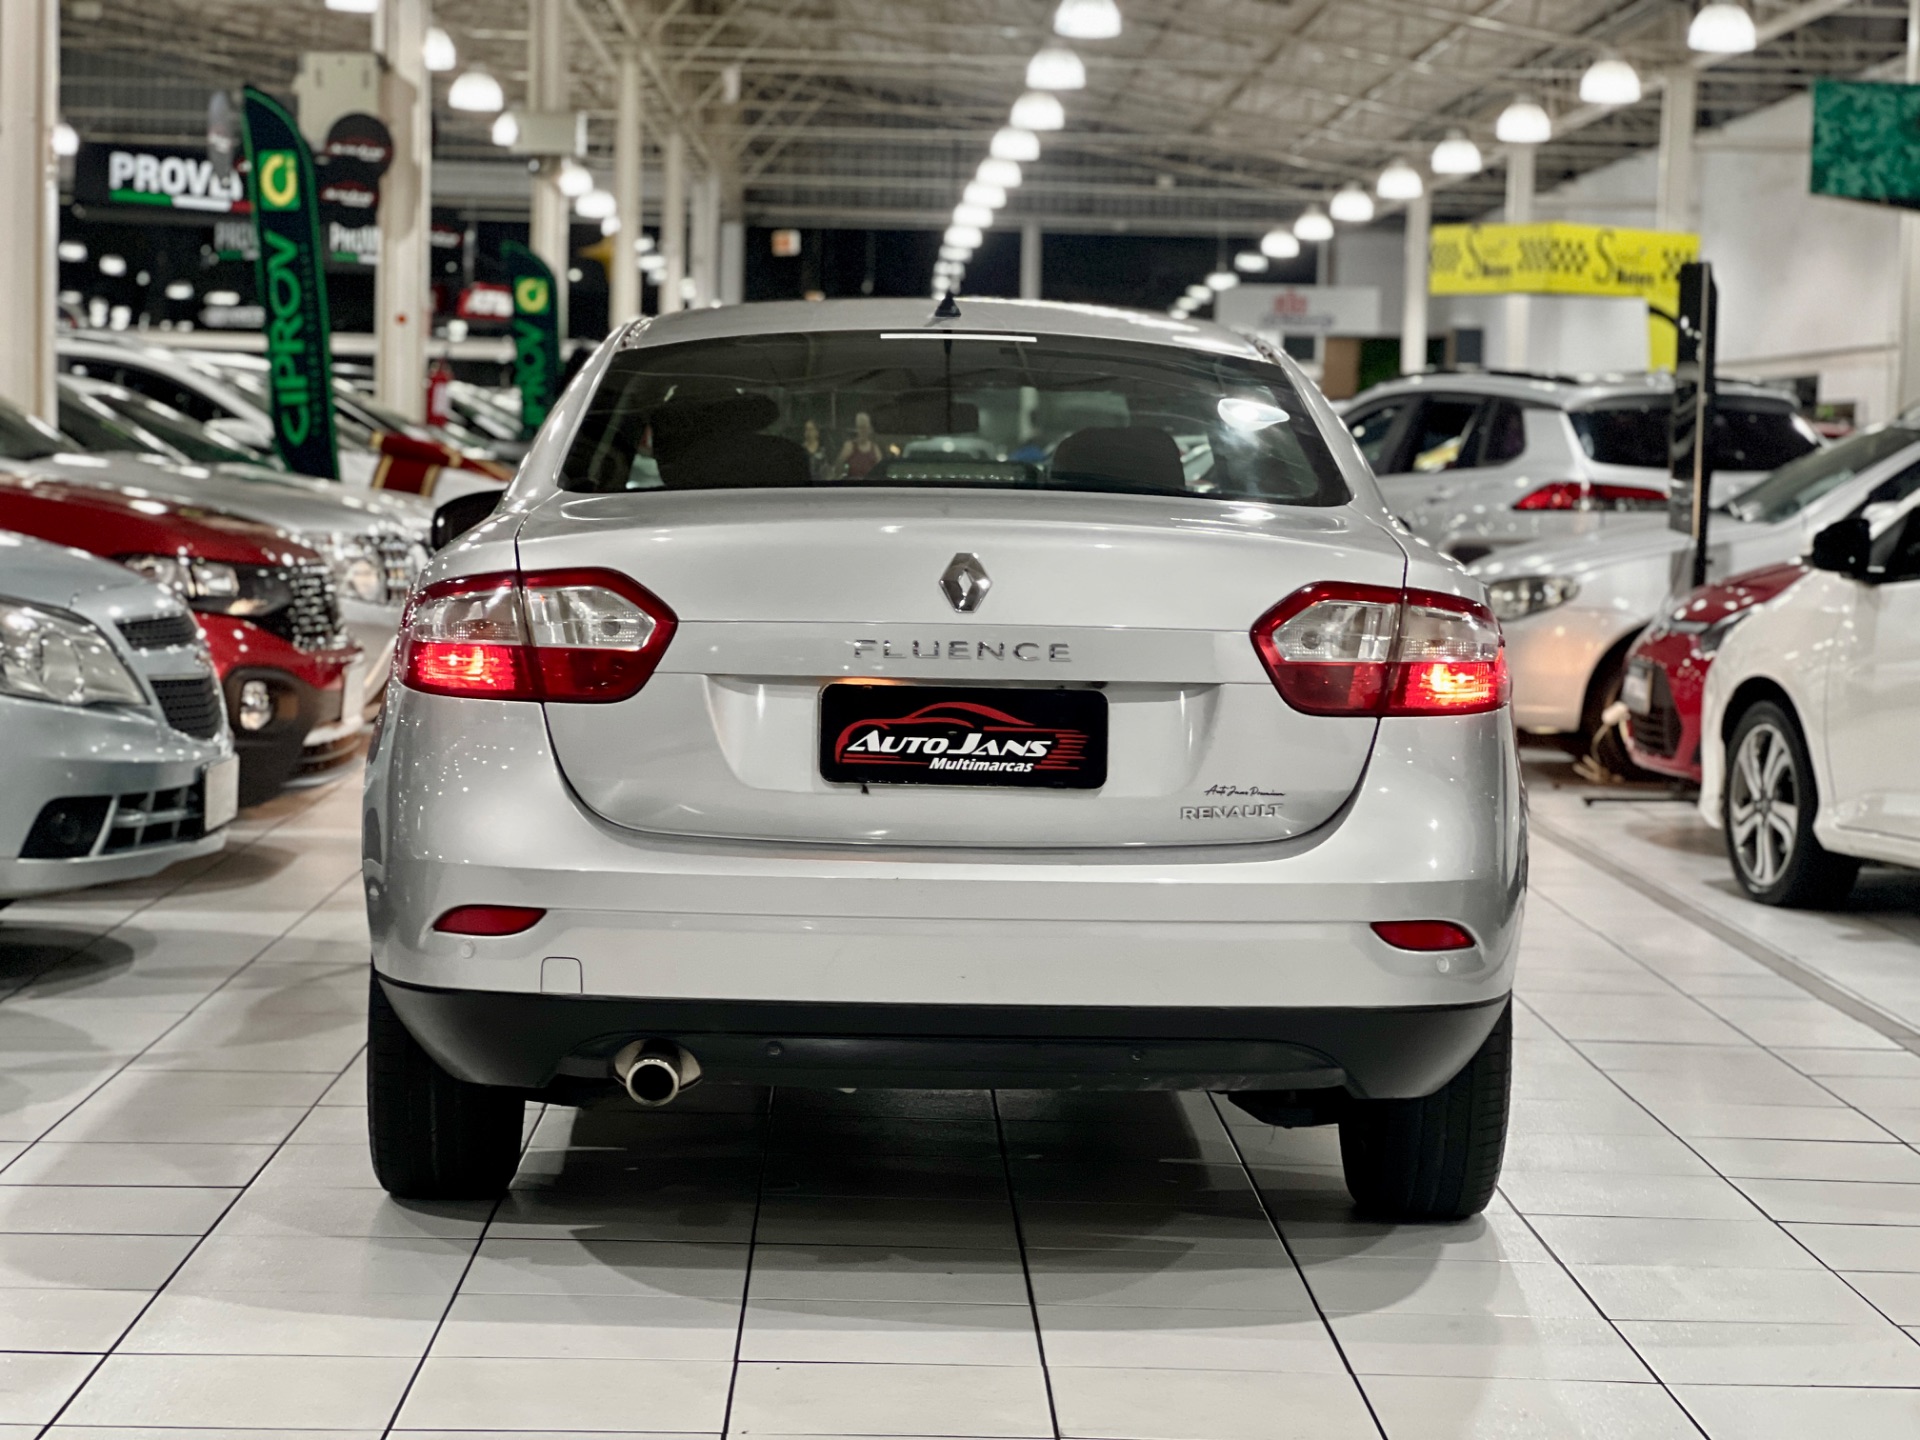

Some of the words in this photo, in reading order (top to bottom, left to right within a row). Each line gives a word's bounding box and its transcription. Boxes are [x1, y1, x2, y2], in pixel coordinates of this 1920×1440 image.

[264, 229, 310, 446] CIPROV
[853, 639, 1073, 662] FLUENCE
[929, 757, 1034, 773] Multimarcas
[1180, 803, 1284, 819] RENAULT
